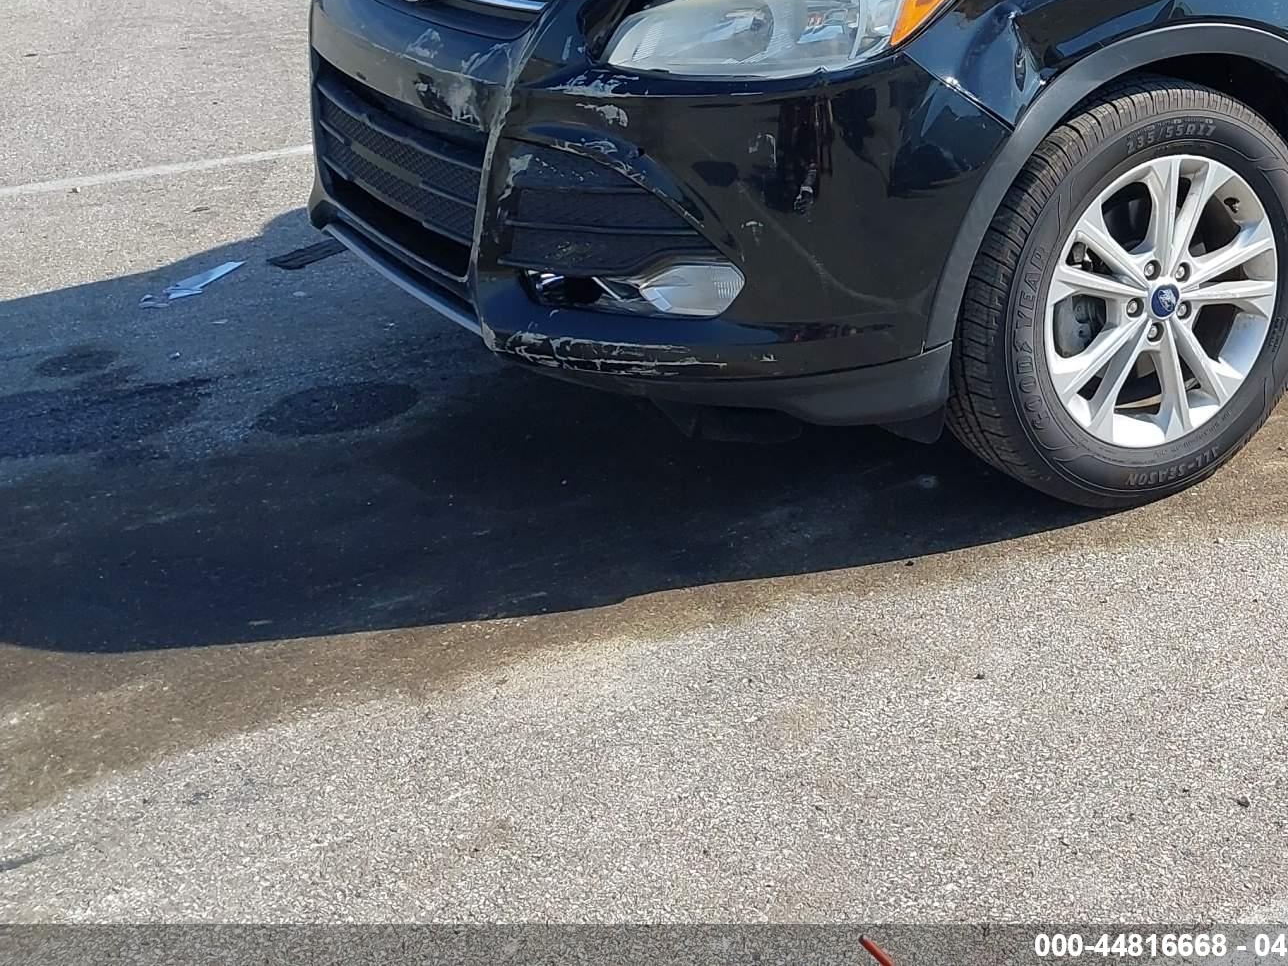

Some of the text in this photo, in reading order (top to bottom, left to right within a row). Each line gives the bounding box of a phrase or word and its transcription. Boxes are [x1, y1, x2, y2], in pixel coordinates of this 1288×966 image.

[1126, 123, 1217, 154] 235/55R17
[1013, 246, 1049, 430] GOODYEAR
[1125, 444, 1220, 486] ALL-SEASON
